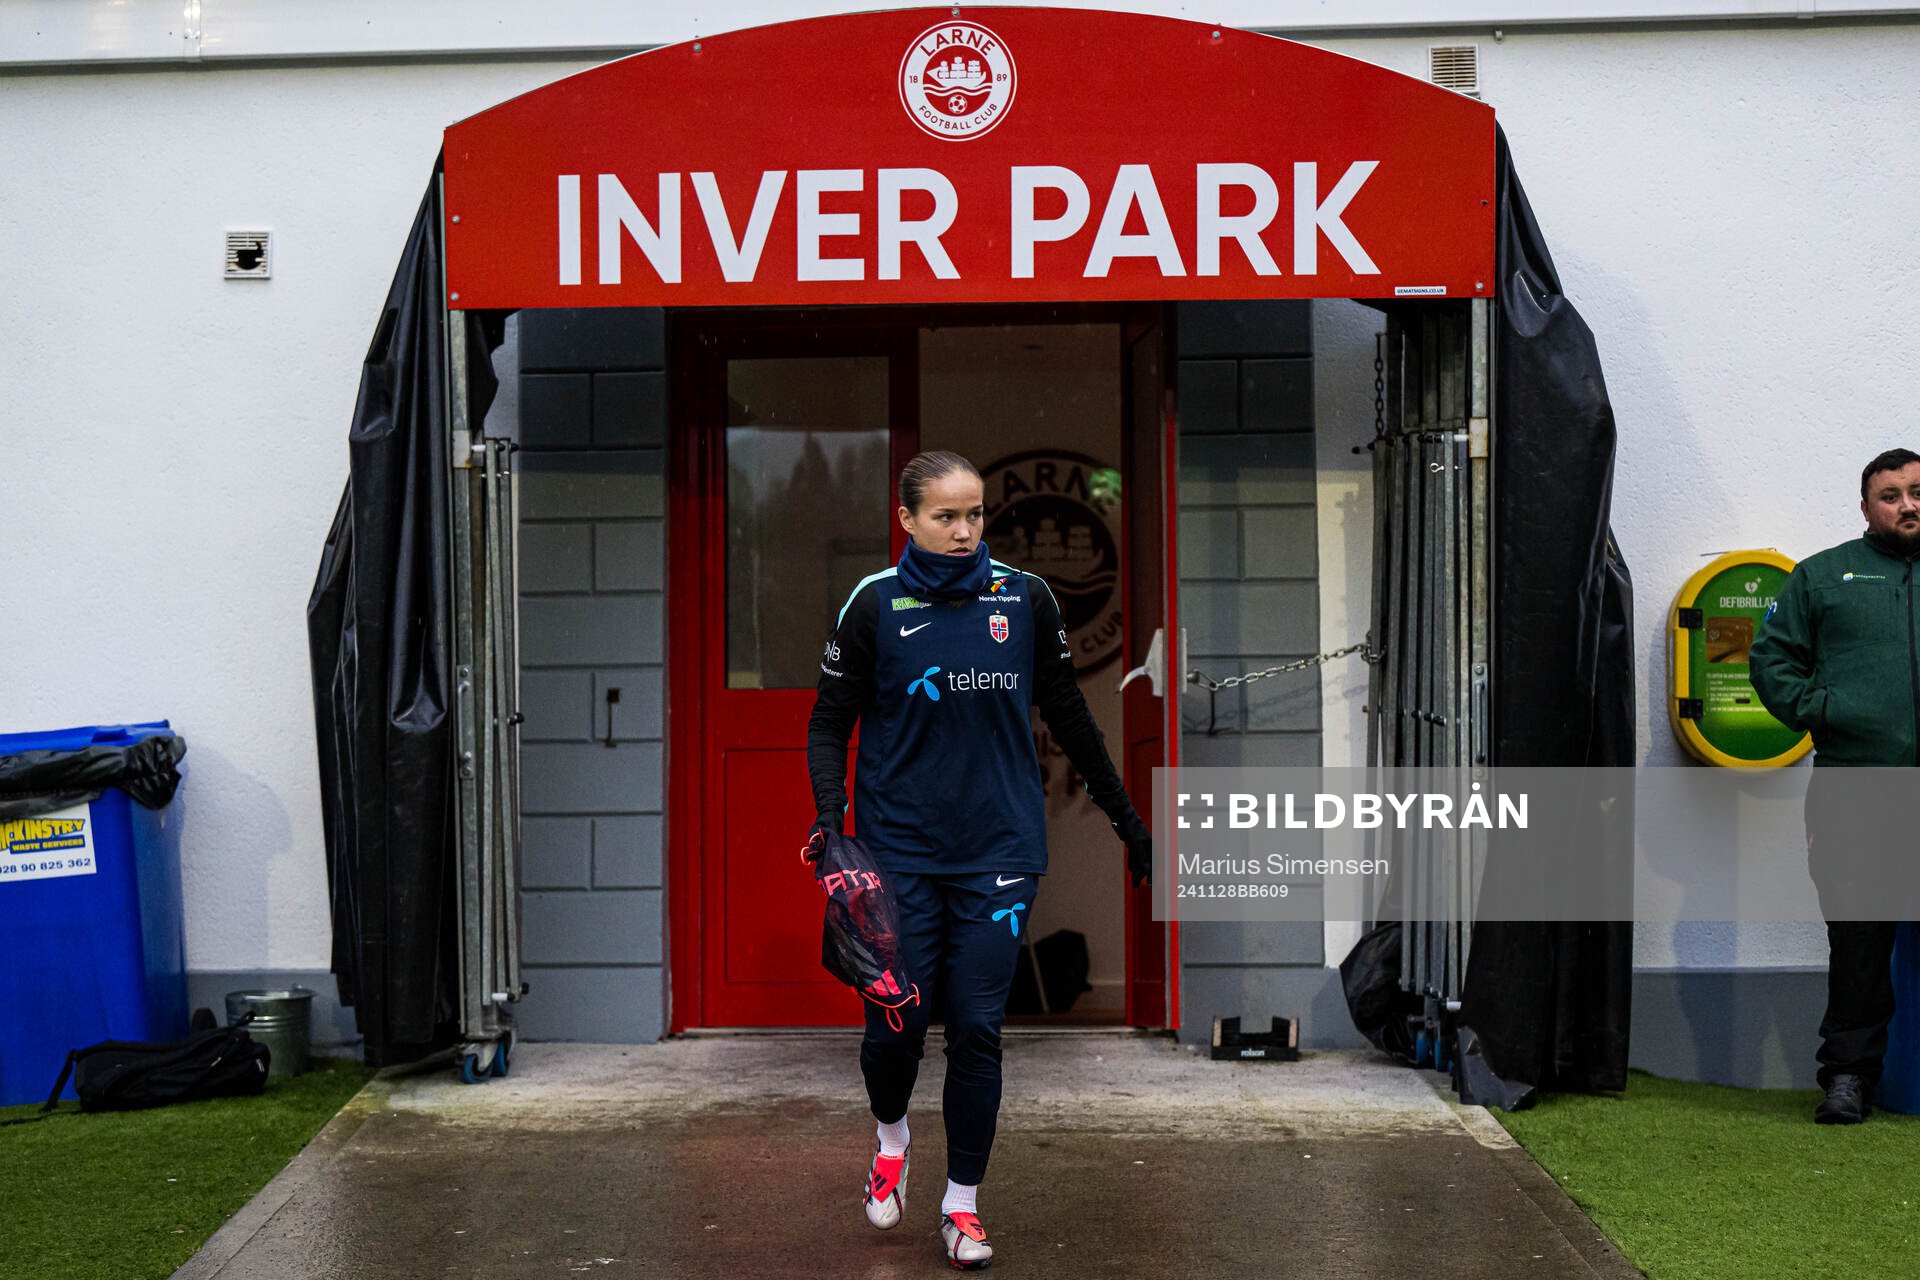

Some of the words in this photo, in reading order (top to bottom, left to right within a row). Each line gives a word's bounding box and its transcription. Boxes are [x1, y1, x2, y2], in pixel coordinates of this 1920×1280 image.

[920, 28, 996, 57] LARNE
[909, 75, 919, 84] 18
[996, 73, 1008, 82] 89
[919, 105, 971, 130] FOOTBALL
[974, 103, 998, 125] CLUB
[558, 167, 962, 286] INVER
[1011, 160, 1382, 279] PARK
[948, 668, 1019, 691] telenor
[12, 842, 40, 852] WASTE
[21, 863, 36, 872] 90
[40, 861, 63, 870] 825
[68, 857, 91, 868] 362
